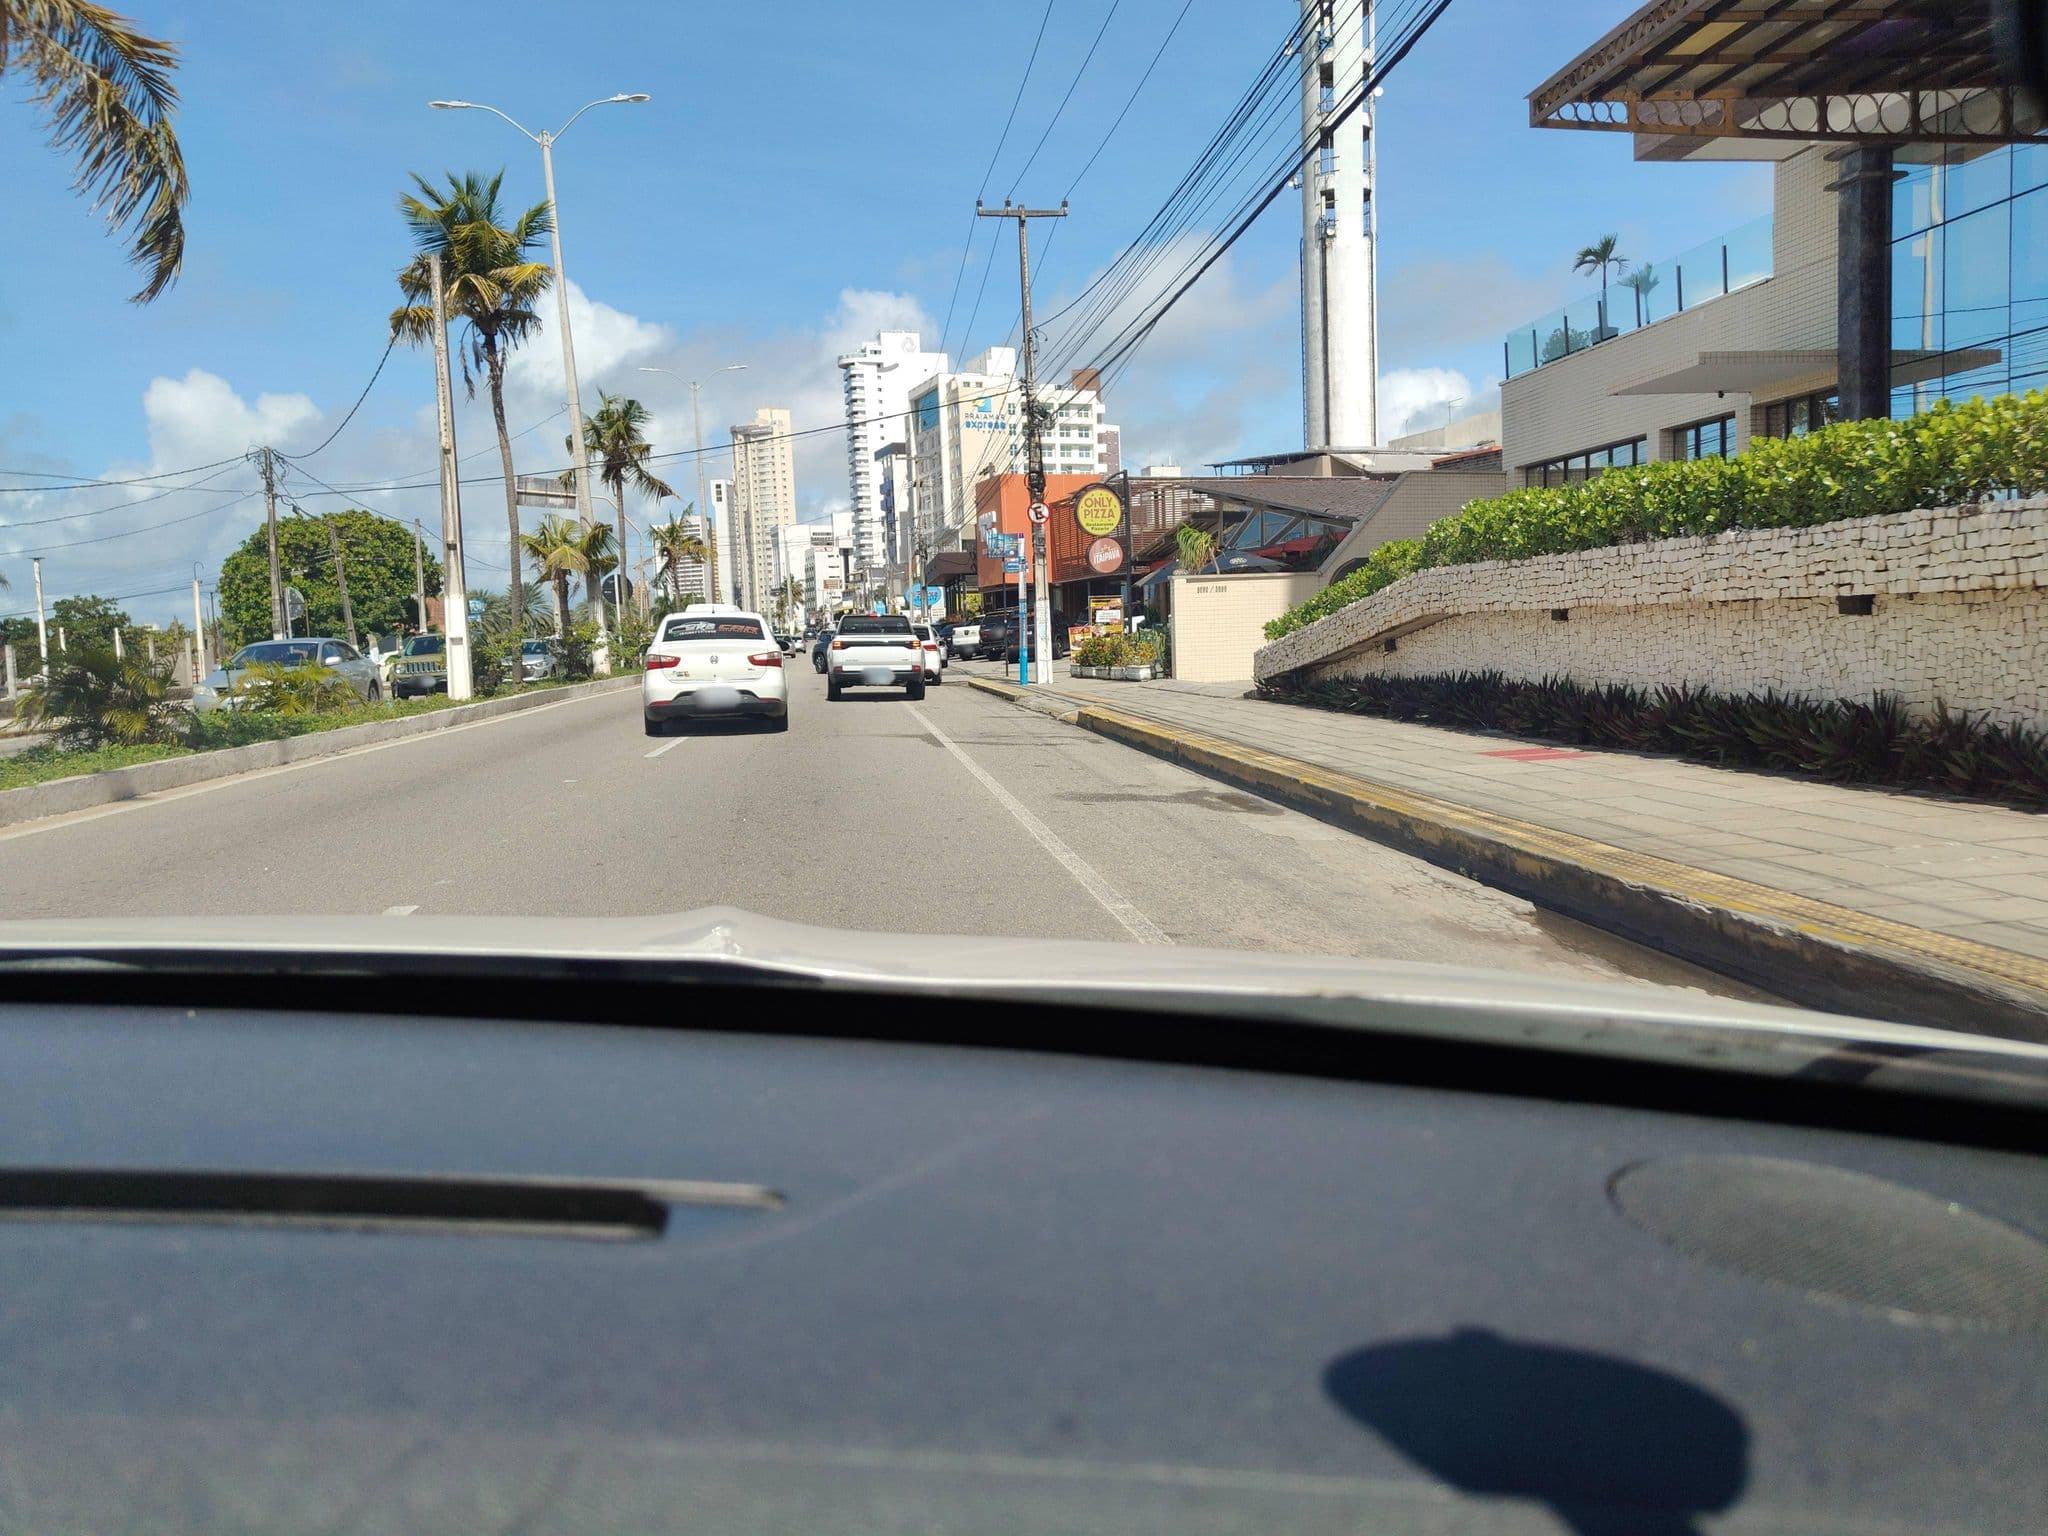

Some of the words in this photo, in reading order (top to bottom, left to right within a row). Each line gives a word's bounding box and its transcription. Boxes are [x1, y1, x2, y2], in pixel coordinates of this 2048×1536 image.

[965, 420, 1006, 431] express
[1084, 497, 1113, 508] ONLY
[1084, 508, 1116, 519] PIZZA
[1094, 548, 1121, 564] ITAIPAVA
